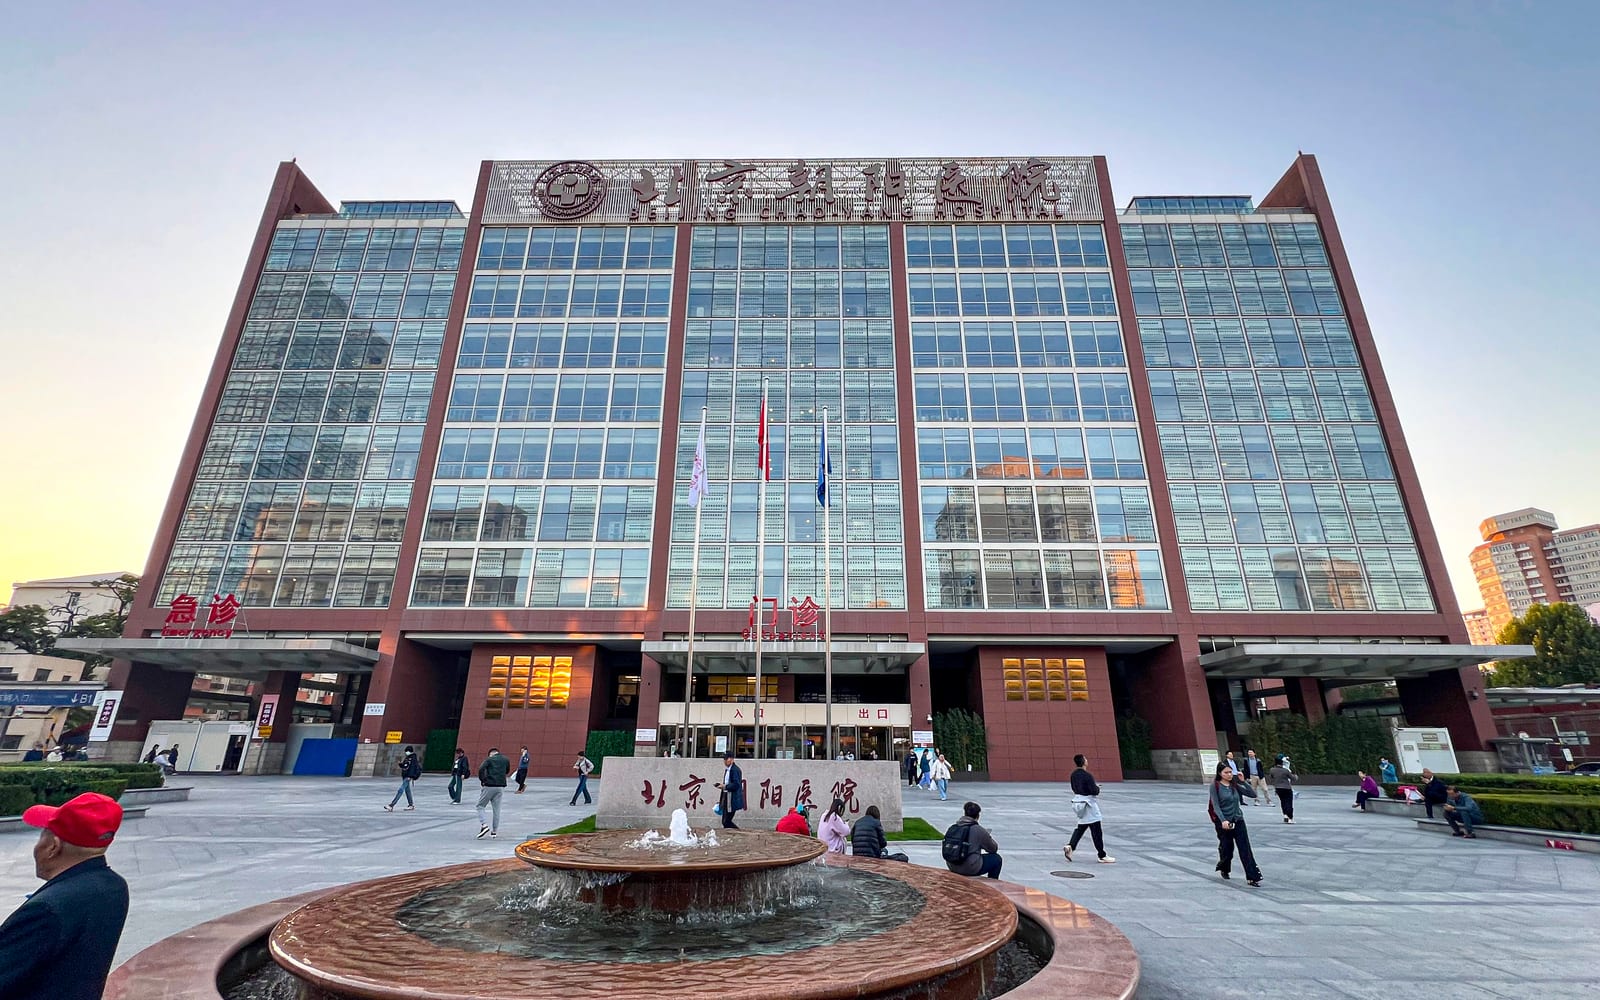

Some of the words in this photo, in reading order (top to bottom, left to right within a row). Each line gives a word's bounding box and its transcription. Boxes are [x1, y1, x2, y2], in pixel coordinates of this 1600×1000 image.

[632, 157, 1061, 205] 北京朝阳医院
[629, 206, 737, 220] BEIJING
[759, 206, 915, 220] CHAO-YANG
[934, 202, 1064, 220] HOSPITAL
[165, 593, 241, 625] 急诊
[748, 595, 821, 628] 门诊
[161, 626, 234, 640] Emergency
[80, 694, 92, 704] B1
[734, 708, 765, 719] 入口
[858, 708, 888, 720] 出口
[641, 774, 860, 814] 北京阳医院
